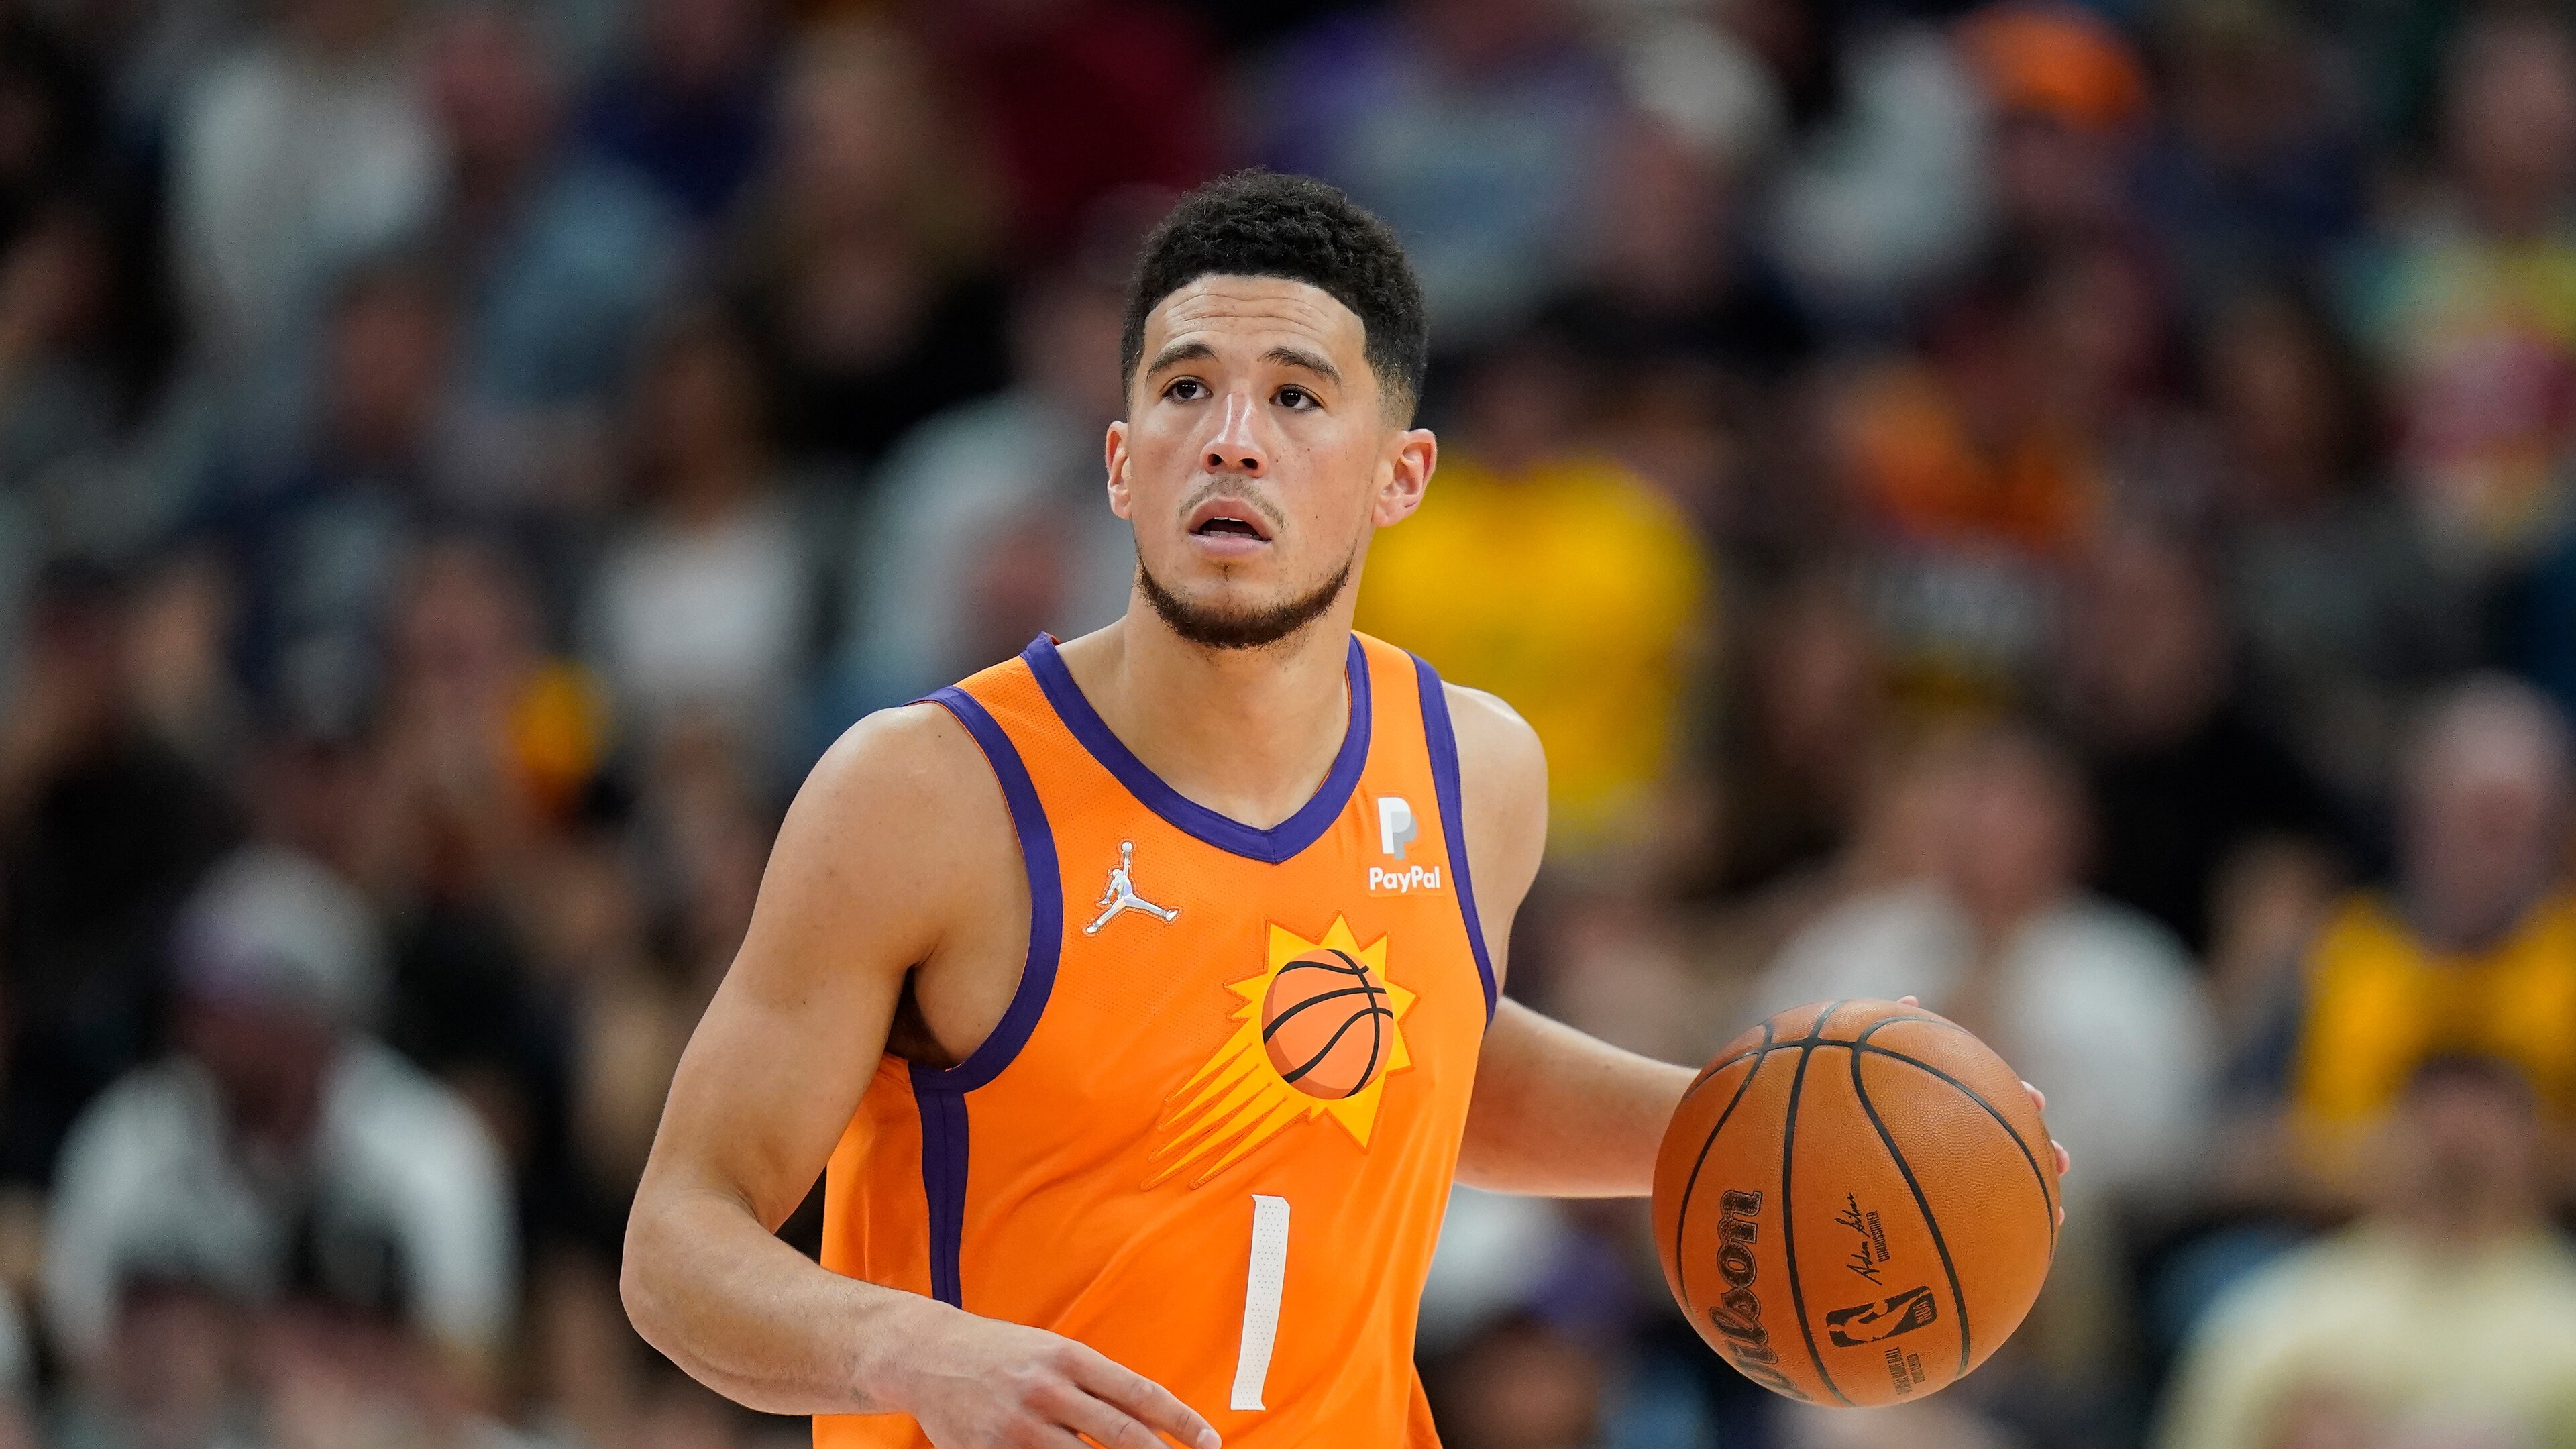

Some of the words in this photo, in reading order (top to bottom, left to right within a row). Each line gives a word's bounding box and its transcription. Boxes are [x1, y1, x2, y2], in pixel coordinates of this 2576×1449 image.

[1368, 865, 1441, 893] PayPal
[1866, 1210, 1890, 1263] COMMISSIONER
[1230, 1194, 1291, 1411] 1
[1913, 1300, 1933, 1324] NBA
